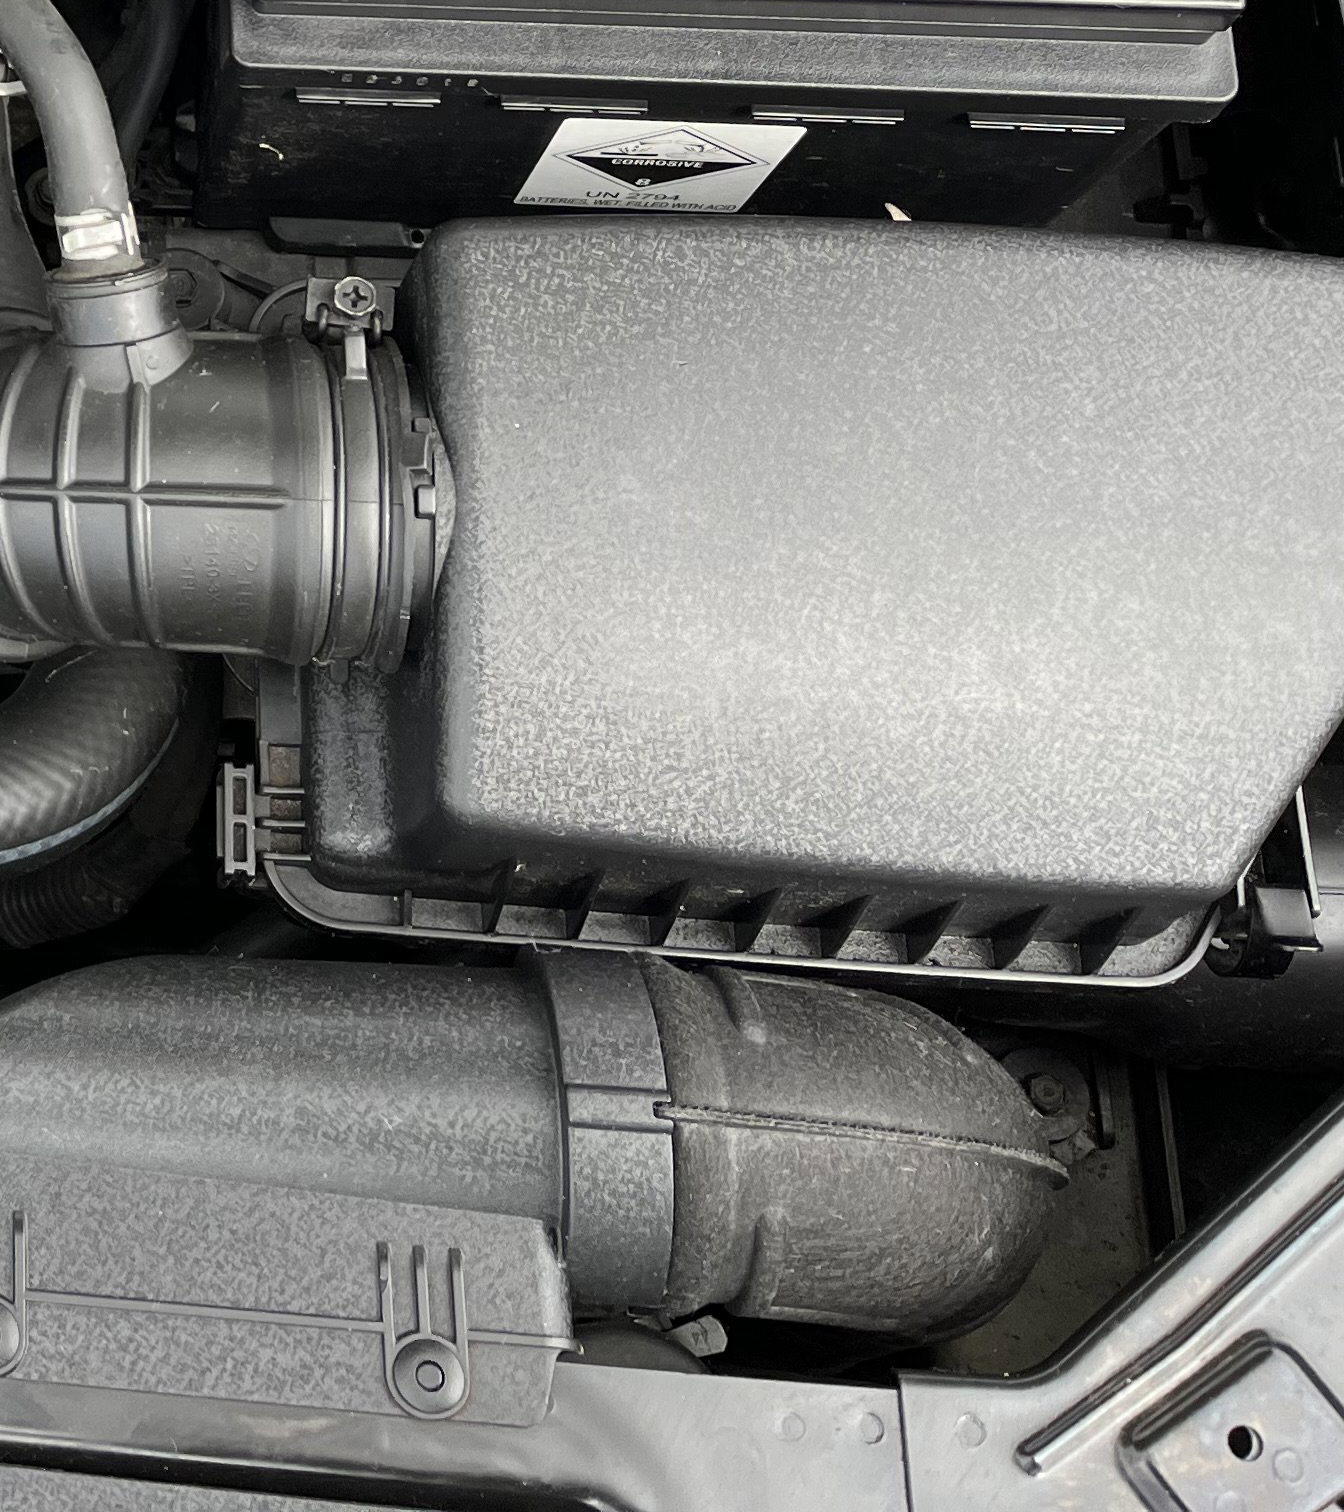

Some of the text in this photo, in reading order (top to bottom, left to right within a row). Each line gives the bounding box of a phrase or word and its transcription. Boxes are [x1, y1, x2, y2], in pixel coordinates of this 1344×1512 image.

[610, 158, 705, 169] CORROSIVE
[586, 191, 681, 201] UN 2794
[519, 196, 590, 206] BATTERIES,
[624, 200, 669, 209] FILLED
[671, 202, 706, 210] WITH
[706, 203, 738, 212] ACID
